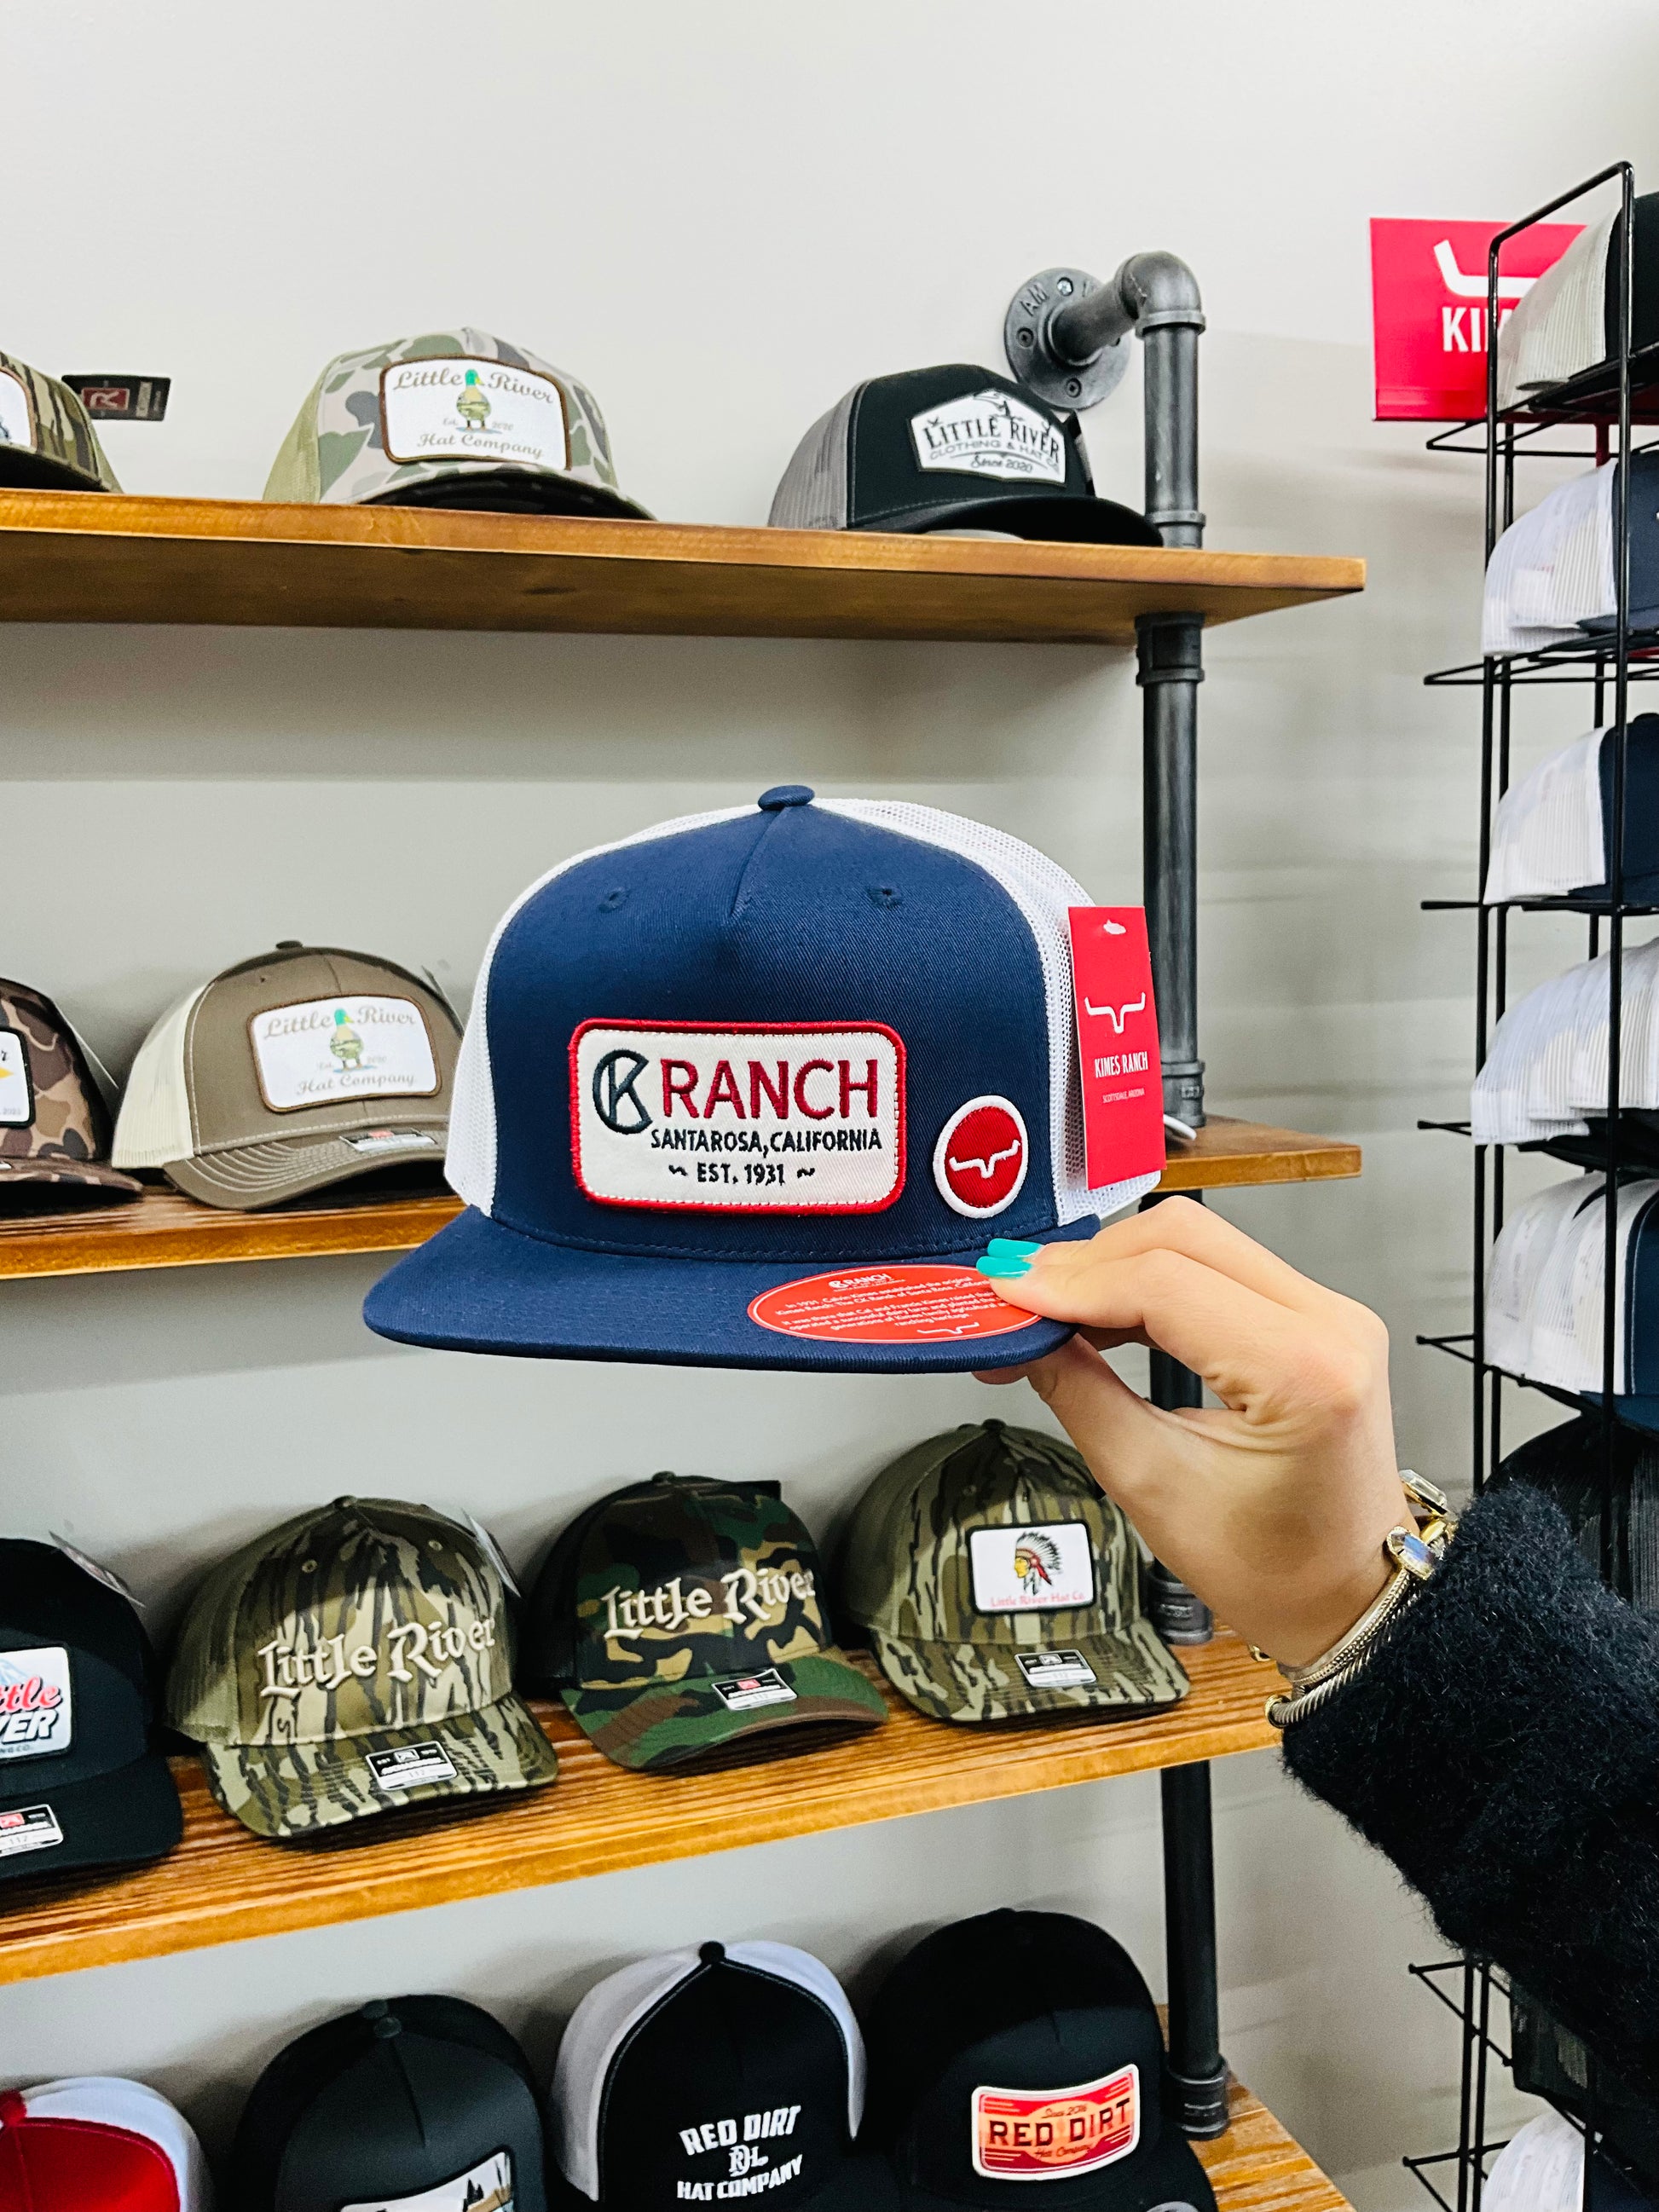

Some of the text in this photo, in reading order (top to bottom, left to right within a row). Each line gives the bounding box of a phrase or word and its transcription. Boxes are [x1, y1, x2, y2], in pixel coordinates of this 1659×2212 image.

[393, 367, 553, 404] Little River
[418, 432, 543, 459] Hat Company
[923, 418, 1060, 464] LITTLE RIVER
[930, 439, 1001, 460] CLOTHING
[1007, 442, 1015, 450] &
[1020, 445, 1043, 459] HAT
[971, 454, 1032, 473] Since 2020
[264, 1005, 417, 1040] Little River
[1095, 1051, 1148, 1078] KIMES RANCH
[297, 1073, 416, 1095] Hat Company
[661, 1058, 878, 1120] RANCH
[697, 1162, 785, 1186] EST. 1931
[600, 1568, 816, 1640] Little River
[991, 1597, 1016, 1607] Little
[1020, 1595, 1047, 1605] River
[1051, 1593, 1070, 1603] Hat
[257, 1619, 495, 1700] Little River
[678, 2105, 801, 2156] RED DIRT
[989, 2097, 1130, 2147] RED DIRT
[1035, 2143, 1093, 2160] Hat Company
[677, 2153, 803, 2201] HAT COMPANY
